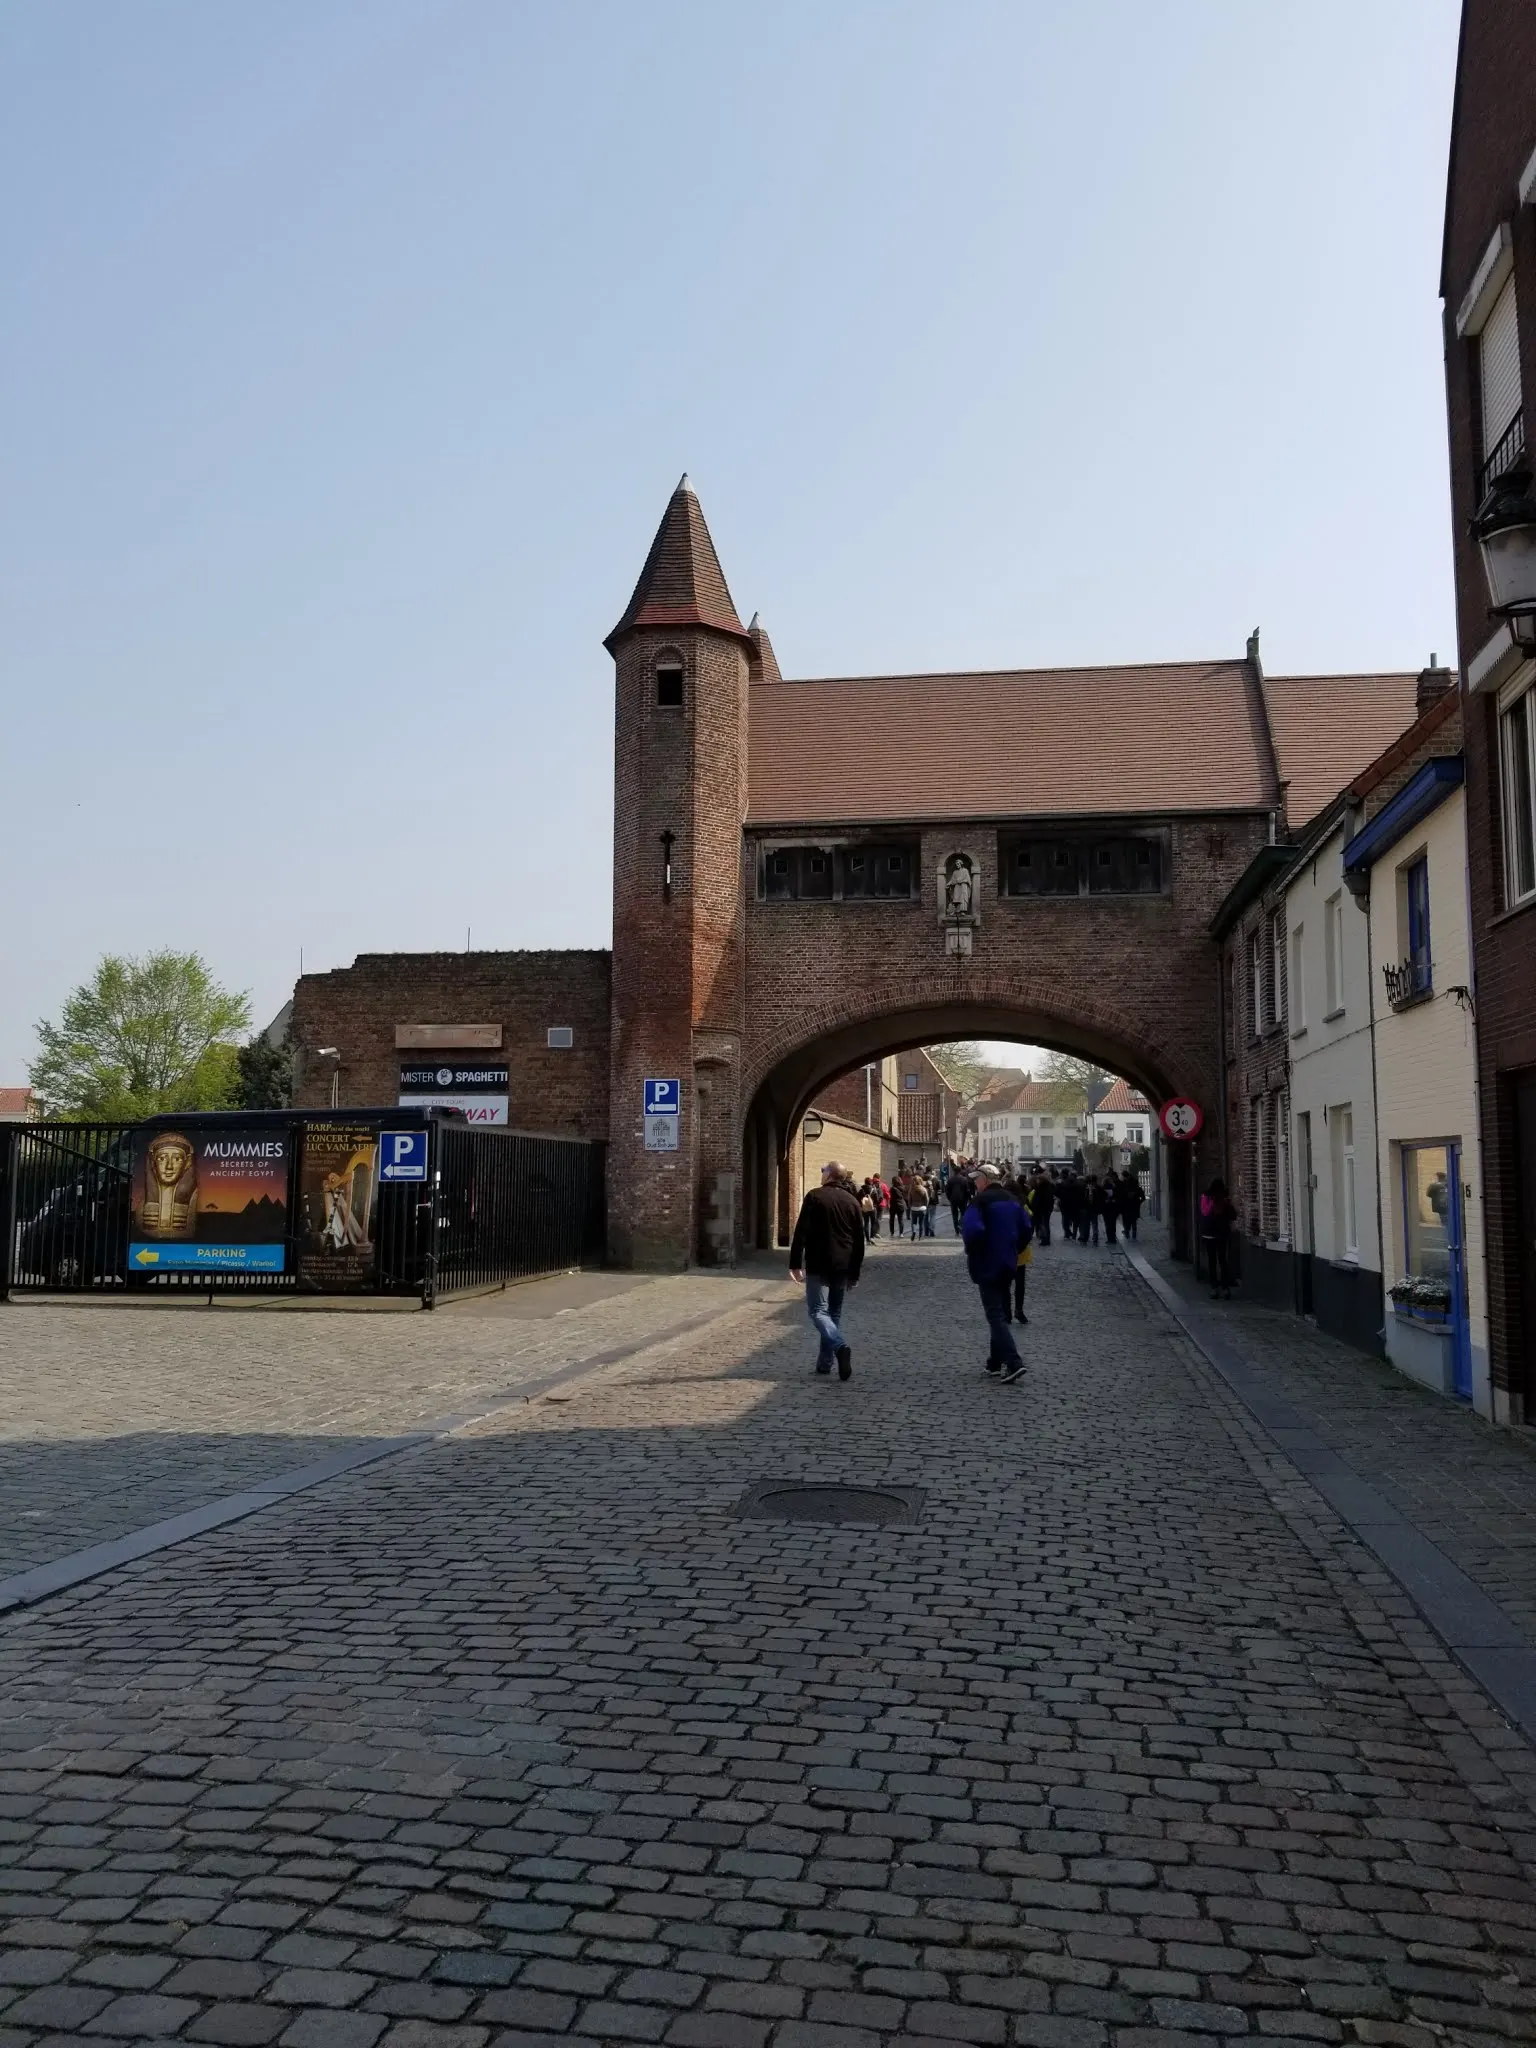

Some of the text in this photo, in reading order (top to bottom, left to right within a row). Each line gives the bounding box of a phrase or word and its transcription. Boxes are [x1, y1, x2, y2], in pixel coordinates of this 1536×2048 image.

[401, 1071, 508, 1082] MISTER SPAGHETTI
[655, 1082, 670, 1102] P
[306, 1134, 350, 1143] CONCERT
[203, 1142, 283, 1158] MUMMIES
[394, 1136, 414, 1163] P
[196, 1248, 247, 1258] PARKING
